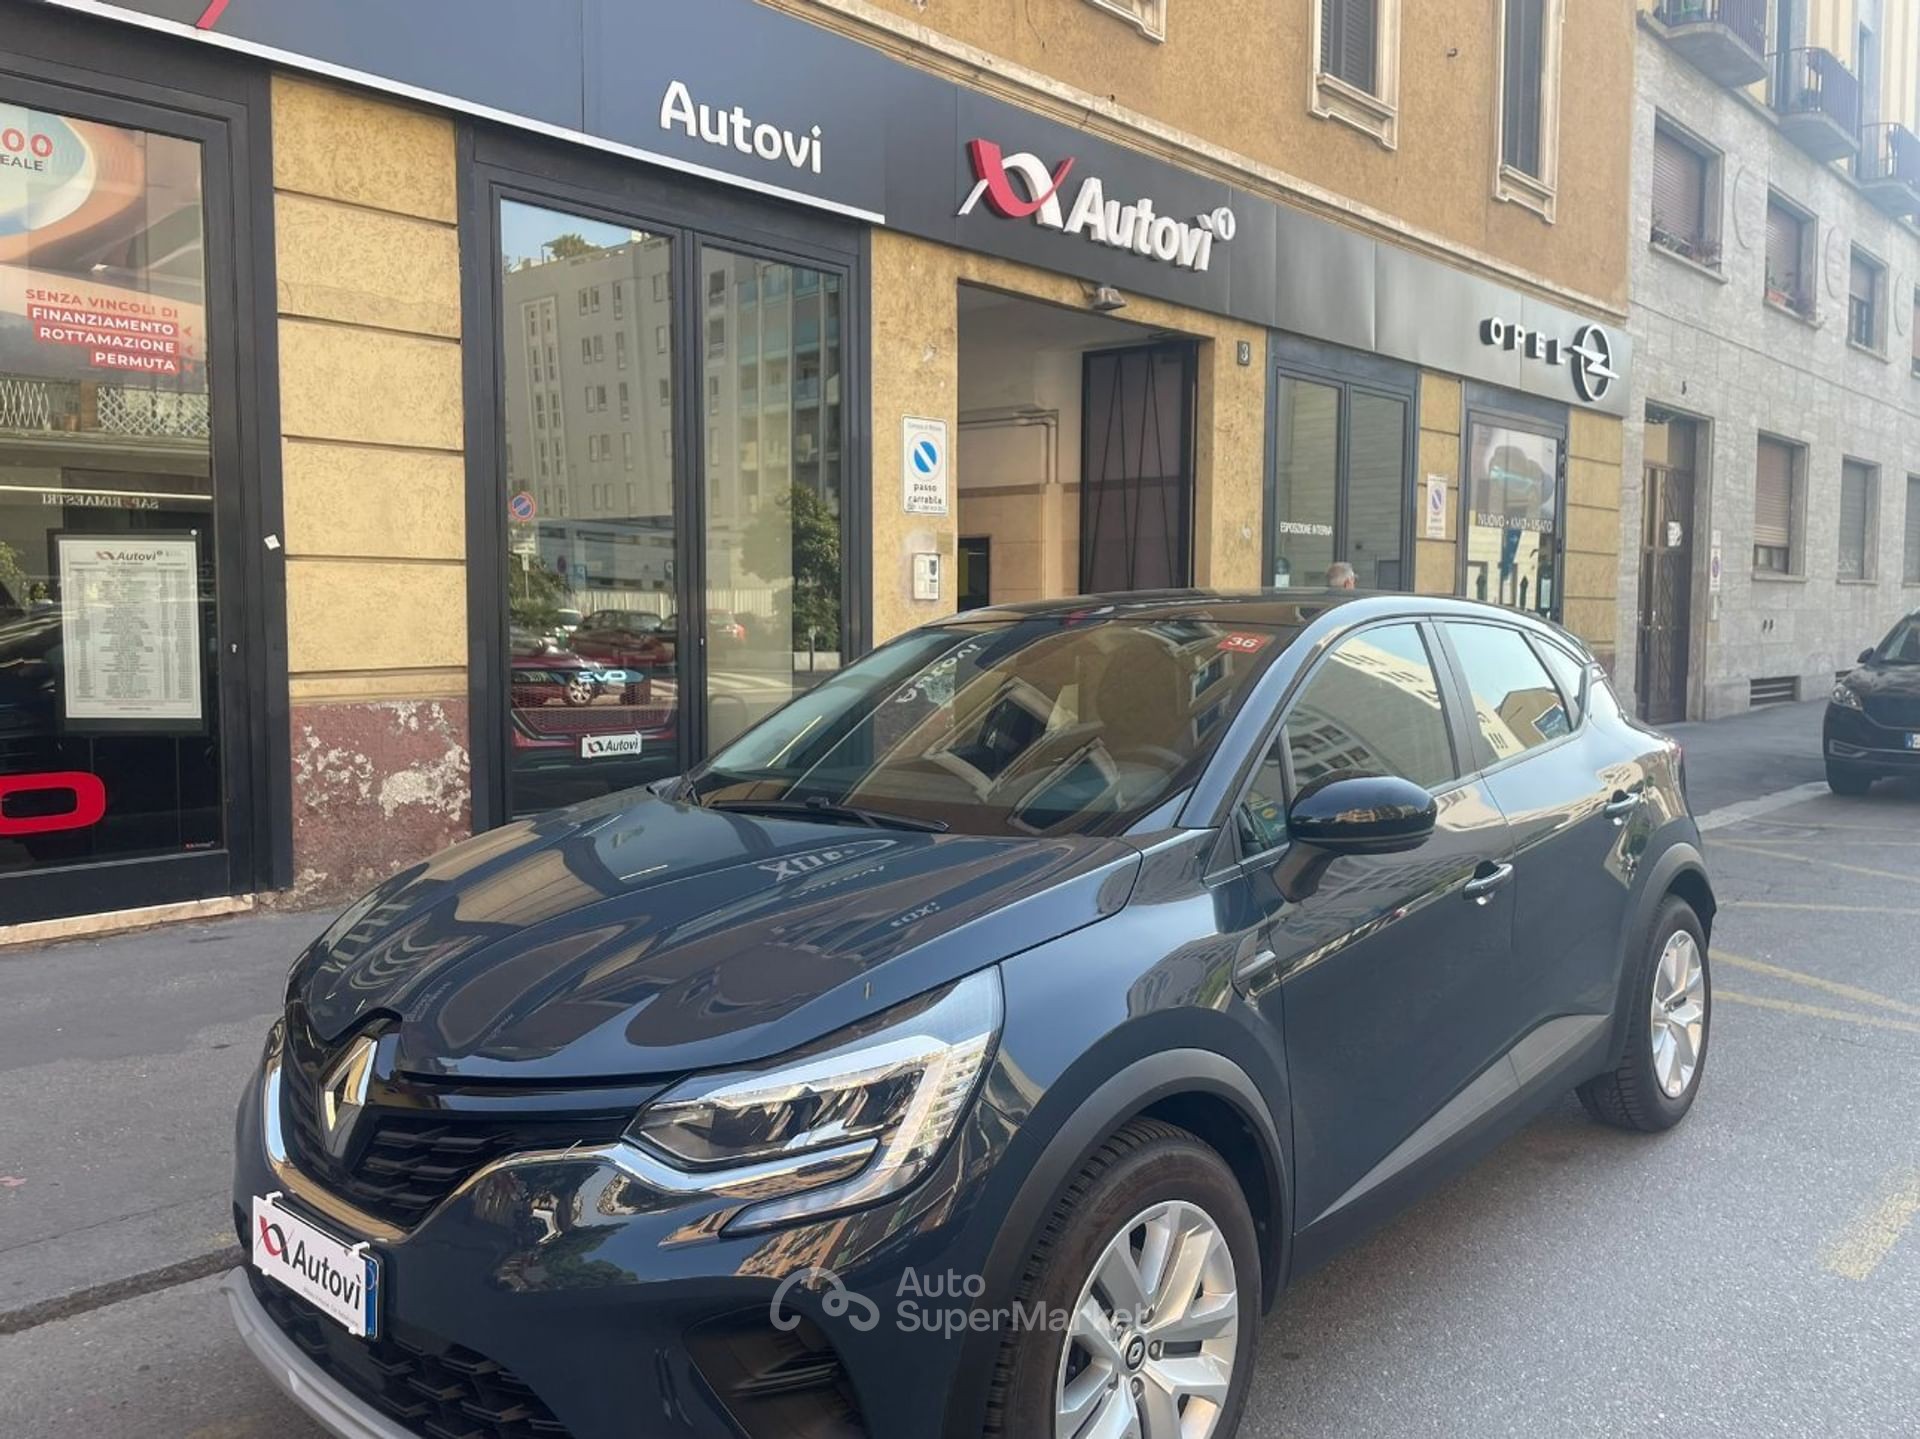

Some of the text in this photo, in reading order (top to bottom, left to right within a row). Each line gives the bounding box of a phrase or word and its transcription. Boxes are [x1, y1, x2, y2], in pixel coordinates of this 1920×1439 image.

[25, 288, 178, 318] SENZA VINCOLI DI
[32, 306, 174, 336] FINANZIAMENTO
[40, 326, 175, 354] ROTTAMAZIONE
[1480, 316, 1566, 365] OPEL
[95, 351, 176, 371] PERMUTA
[1227, 636, 1259, 649] 36
[578, 669, 627, 682] EVO
